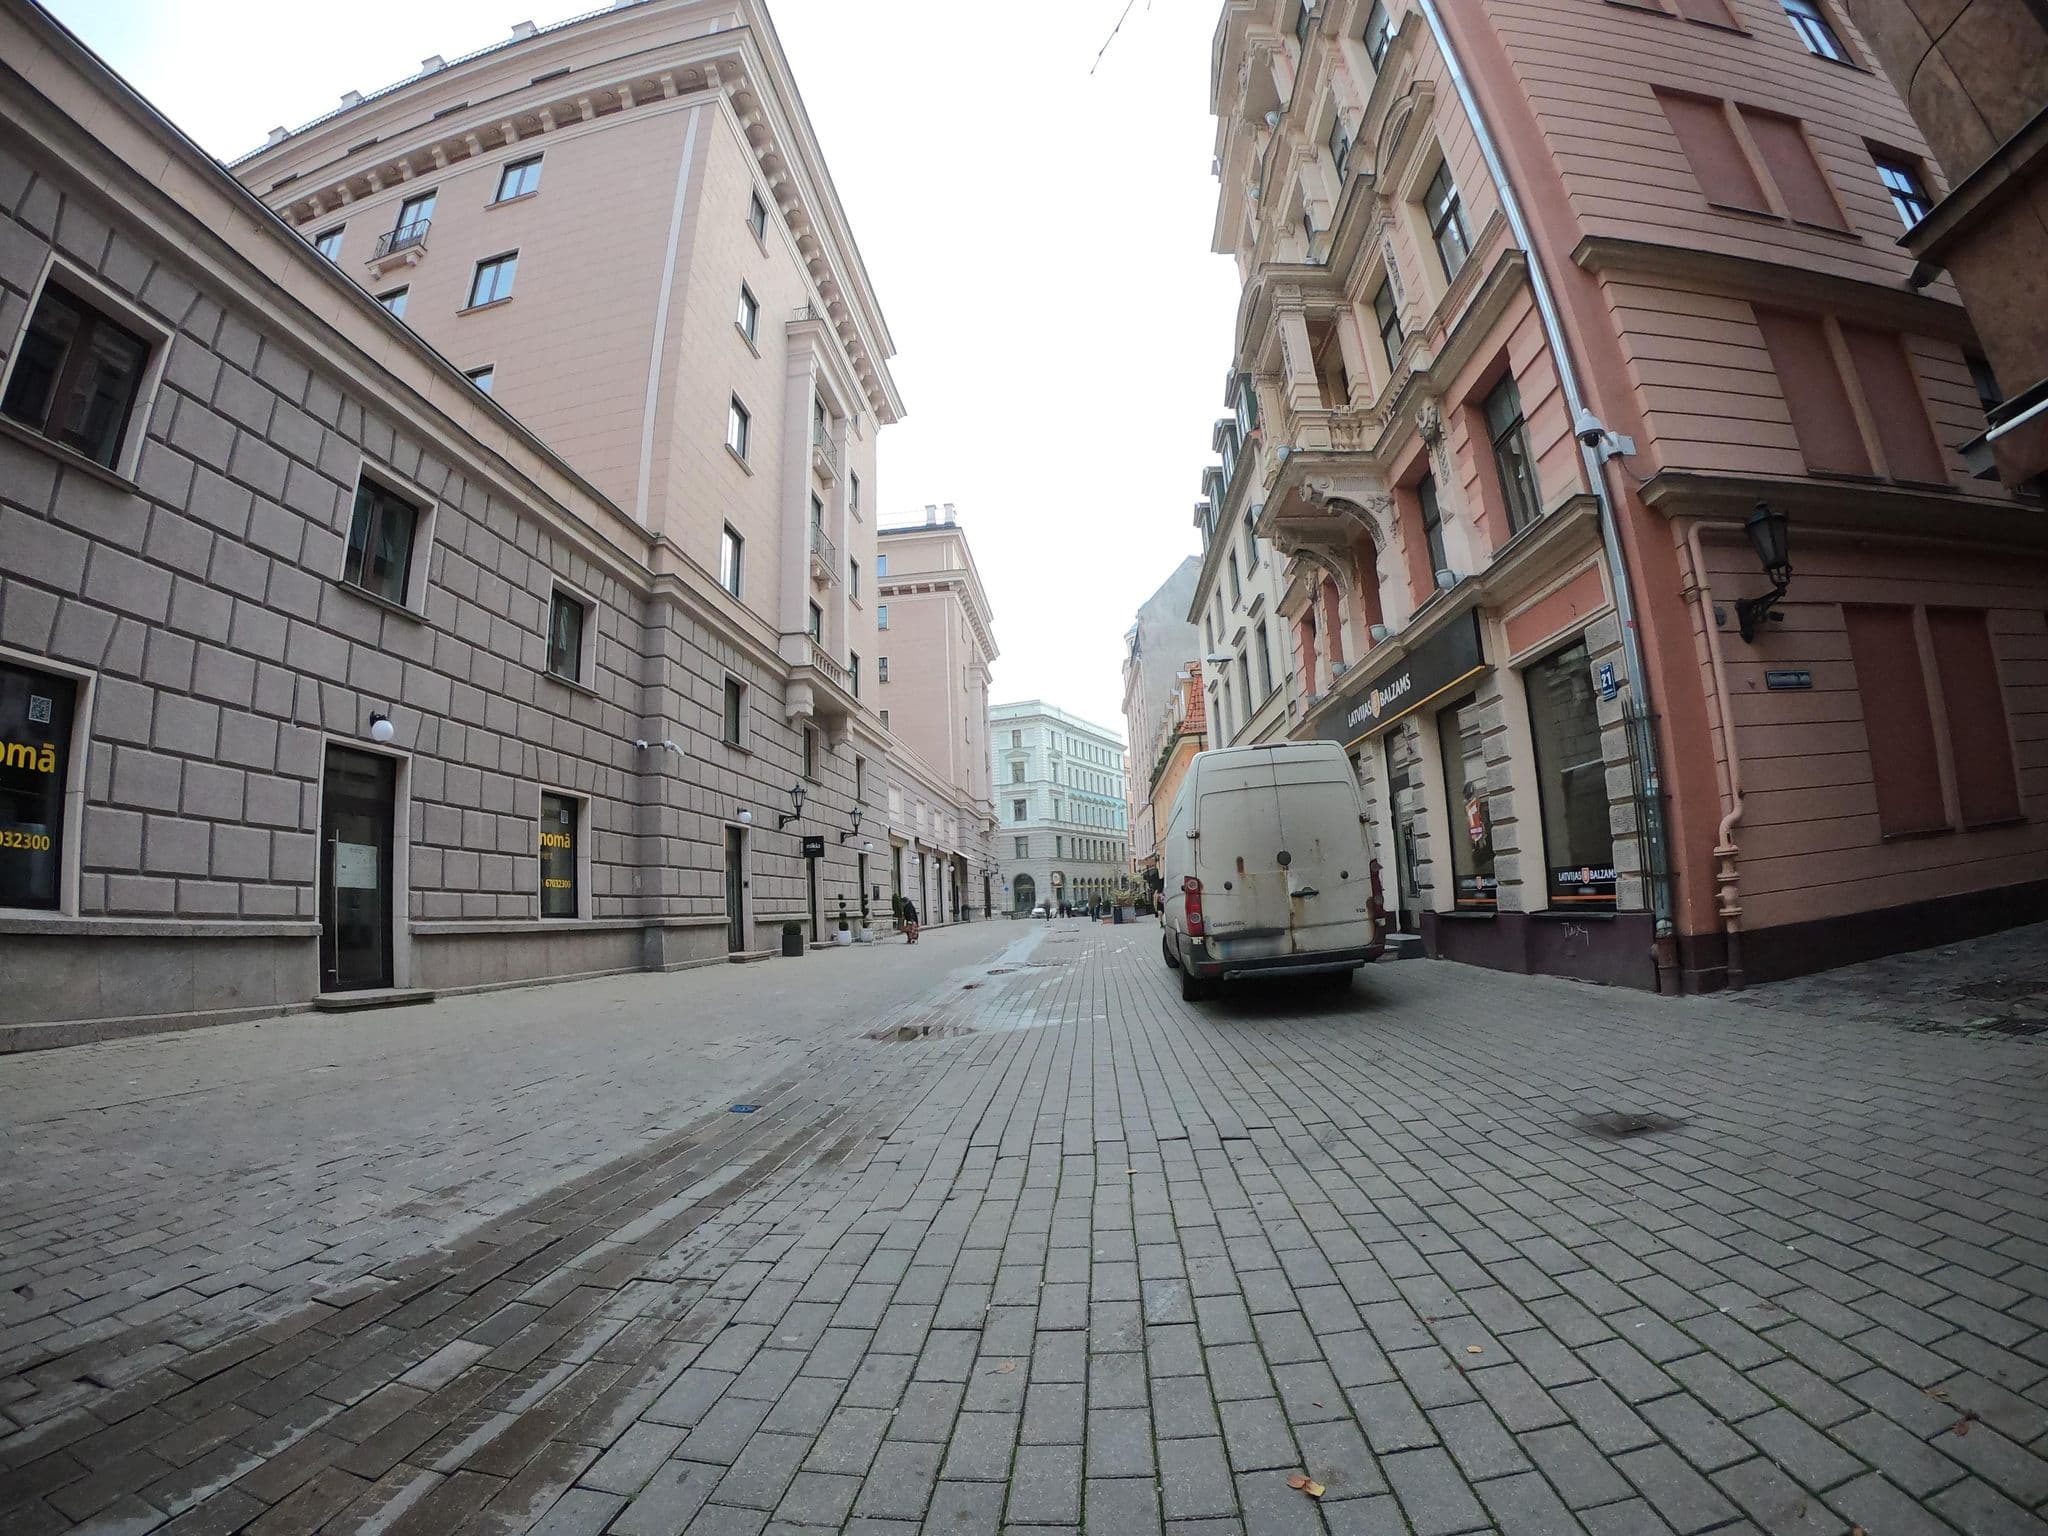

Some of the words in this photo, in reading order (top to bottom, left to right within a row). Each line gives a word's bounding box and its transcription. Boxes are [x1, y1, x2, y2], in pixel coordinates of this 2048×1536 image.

[1601, 671, 1612, 688] 21
[1347, 700, 1372, 728] LATVIJAS
[1380, 672, 1411, 707] BALZAMS
[545, 878, 571, 889] 67032300
[1558, 871, 1582, 882] LATVIJAS
